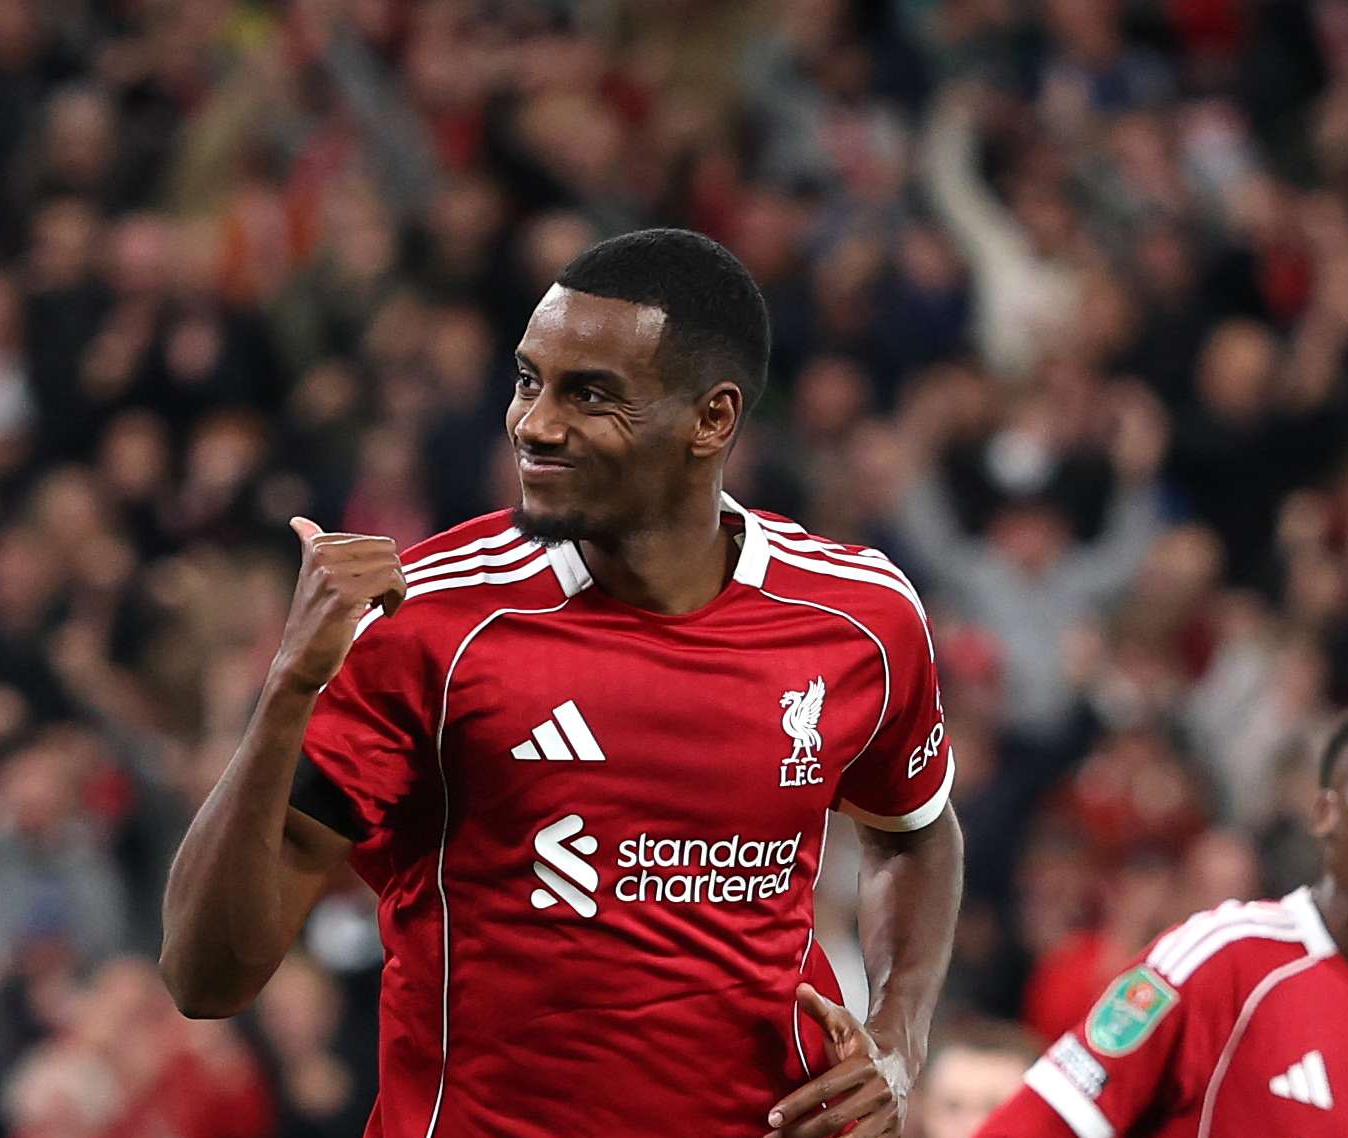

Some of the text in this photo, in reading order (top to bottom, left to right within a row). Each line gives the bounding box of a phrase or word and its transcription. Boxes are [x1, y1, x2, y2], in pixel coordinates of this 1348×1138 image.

[779, 763, 824, 787] L.F.C.
[617, 831, 802, 868] standard
[615, 862, 796, 903] chartered
